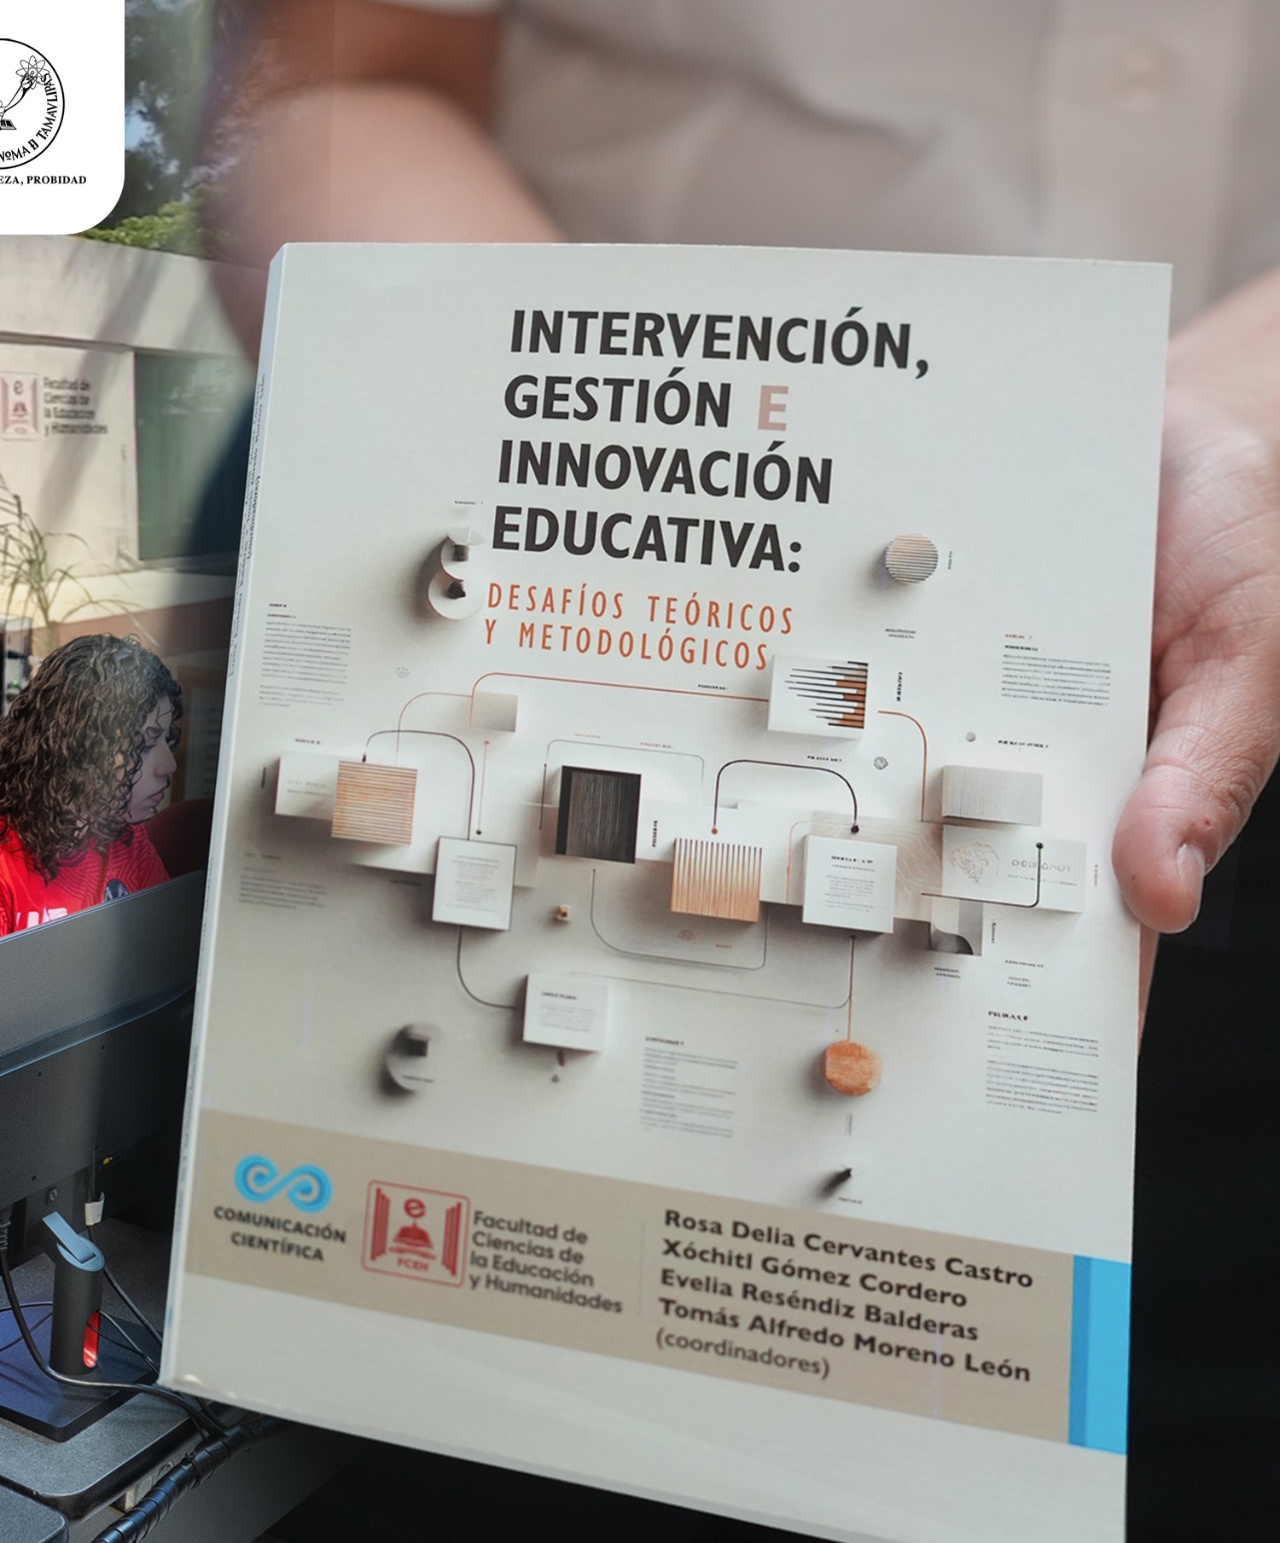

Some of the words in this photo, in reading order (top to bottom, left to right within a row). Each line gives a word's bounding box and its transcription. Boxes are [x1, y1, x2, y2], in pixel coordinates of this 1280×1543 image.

[510, 306, 929, 379] INTERVENCIÓN,
[504, 366, 732, 428] GESTIÓN
[757, 384, 790, 432] E
[498, 440, 833, 505] INNOVACIÓN
[492, 505, 802, 573] EDUCATIVA:
[487, 581, 625, 620] DESAFÍOS
[647, 592, 794, 635] TEÓRICOS
[485, 618, 497, 645] Y
[519, 621, 768, 672] METODOLÓGICOS
[214, 1206, 346, 1244] COMUNICACIÓN
[230, 1231, 324, 1263] CIENTÍFICA
[471, 1230, 555, 1261] Ciencias
[558, 1246, 584, 1265] de
[473, 1210, 558, 1242] Facultad
[561, 1228, 588, 1246] de
[664, 1209, 723, 1236] Rosa
[731, 1221, 796, 1248] Delia
[804, 1233, 937, 1272] Cervantes
[945, 1257, 1034, 1289] Castro
[468, 1274, 480, 1291] y
[484, 1275, 624, 1315] Humanidades
[470, 1250, 489, 1270] la
[492, 1255, 595, 1288] Educación
[662, 1239, 754, 1271] Xóchitl
[761, 1256, 852, 1288] Gómez
[859, 1273, 967, 1308] Cordero
[660, 1269, 733, 1299] Evelia
[741, 1283, 856, 1320] Reséndiz
[864, 1304, 979, 1342] Balderas
[655, 1327, 831, 1380] (coordinadores)
[658, 1297, 740, 1329] Tomás
[748, 1314, 845, 1348] Alfredo
[853, 1334, 955, 1368] Moreno
[964, 1353, 1031, 1383] León
